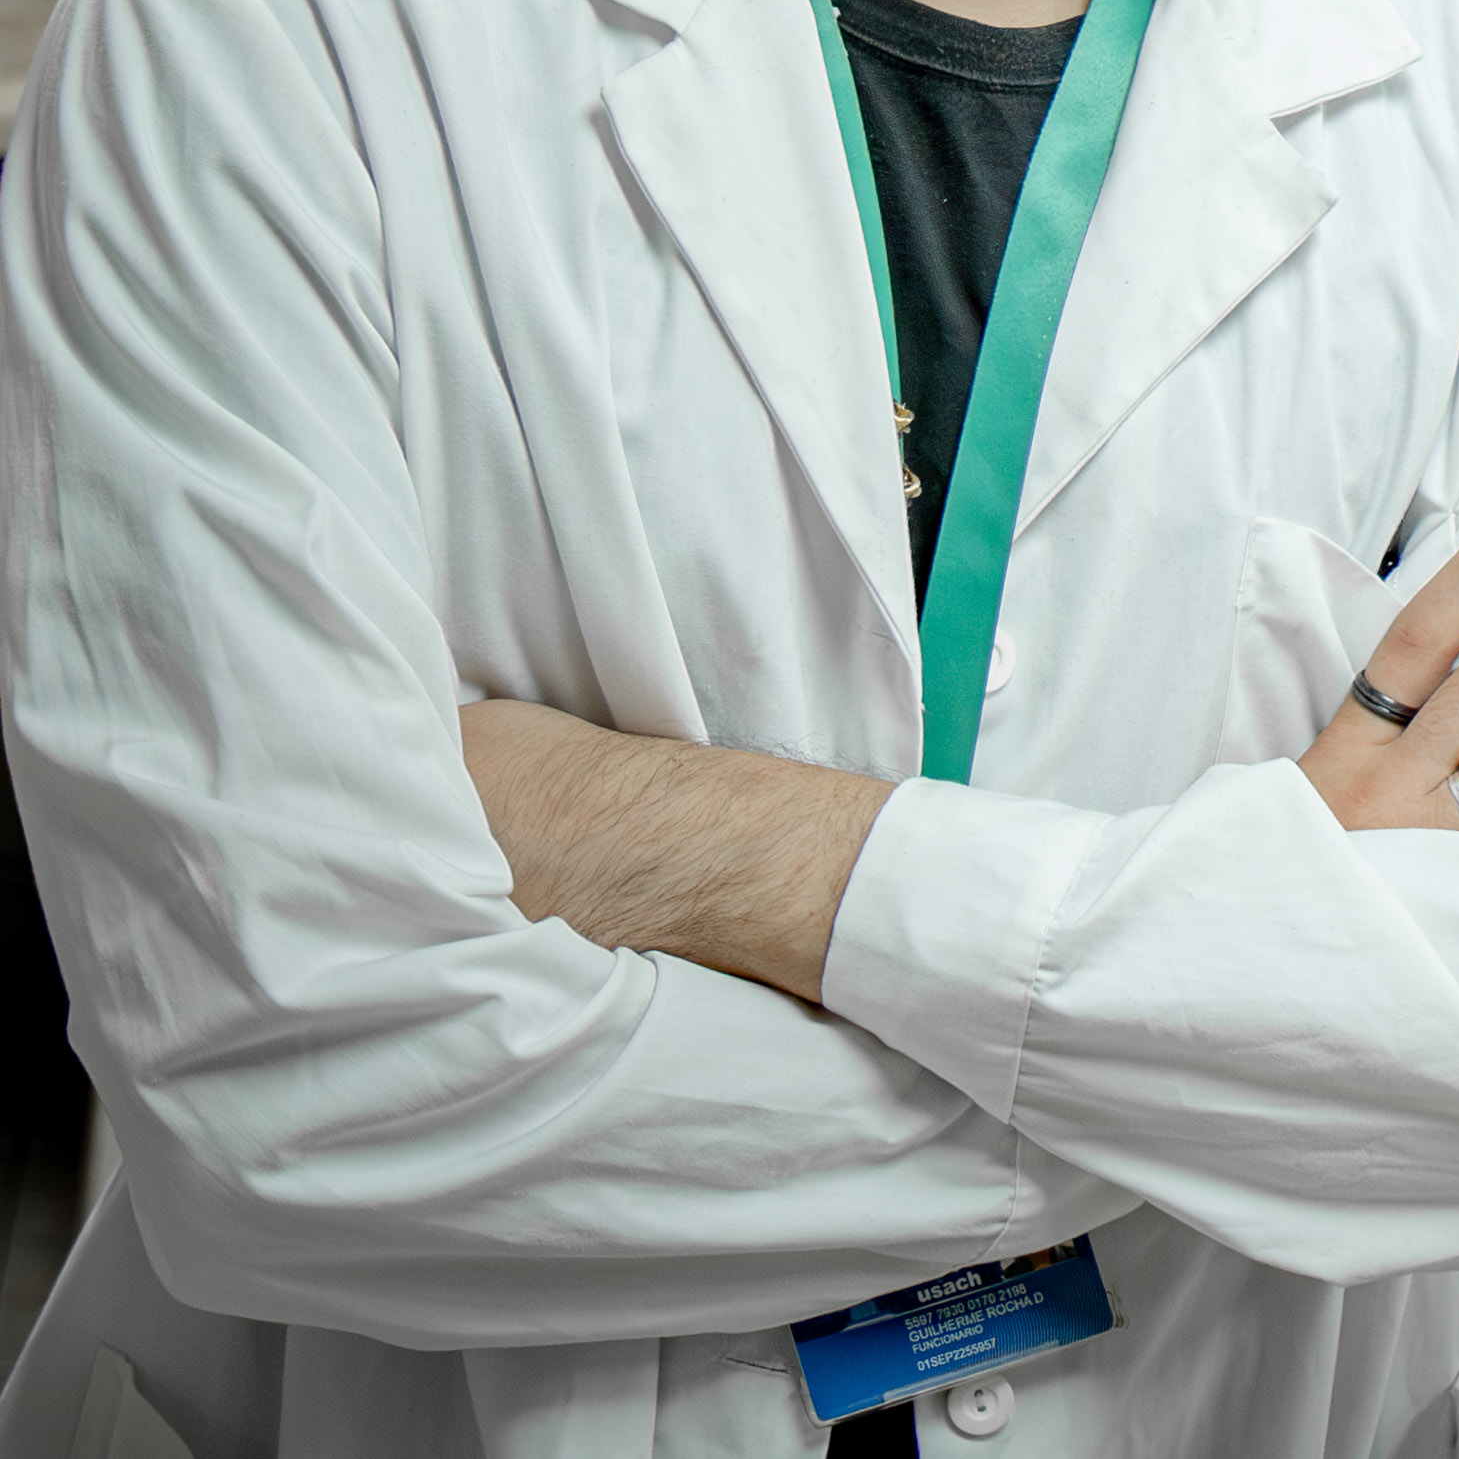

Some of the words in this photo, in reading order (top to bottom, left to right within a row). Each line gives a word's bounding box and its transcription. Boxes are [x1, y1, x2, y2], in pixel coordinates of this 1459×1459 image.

[917, 1271, 982, 1303] usach
[909, 1310, 985, 1342] GUILHERME
[986, 1295, 1033, 1319] ROCHA
[1033, 1291, 1044, 1304] D
[912, 1324, 984, 1354] FUNCIONARIO
